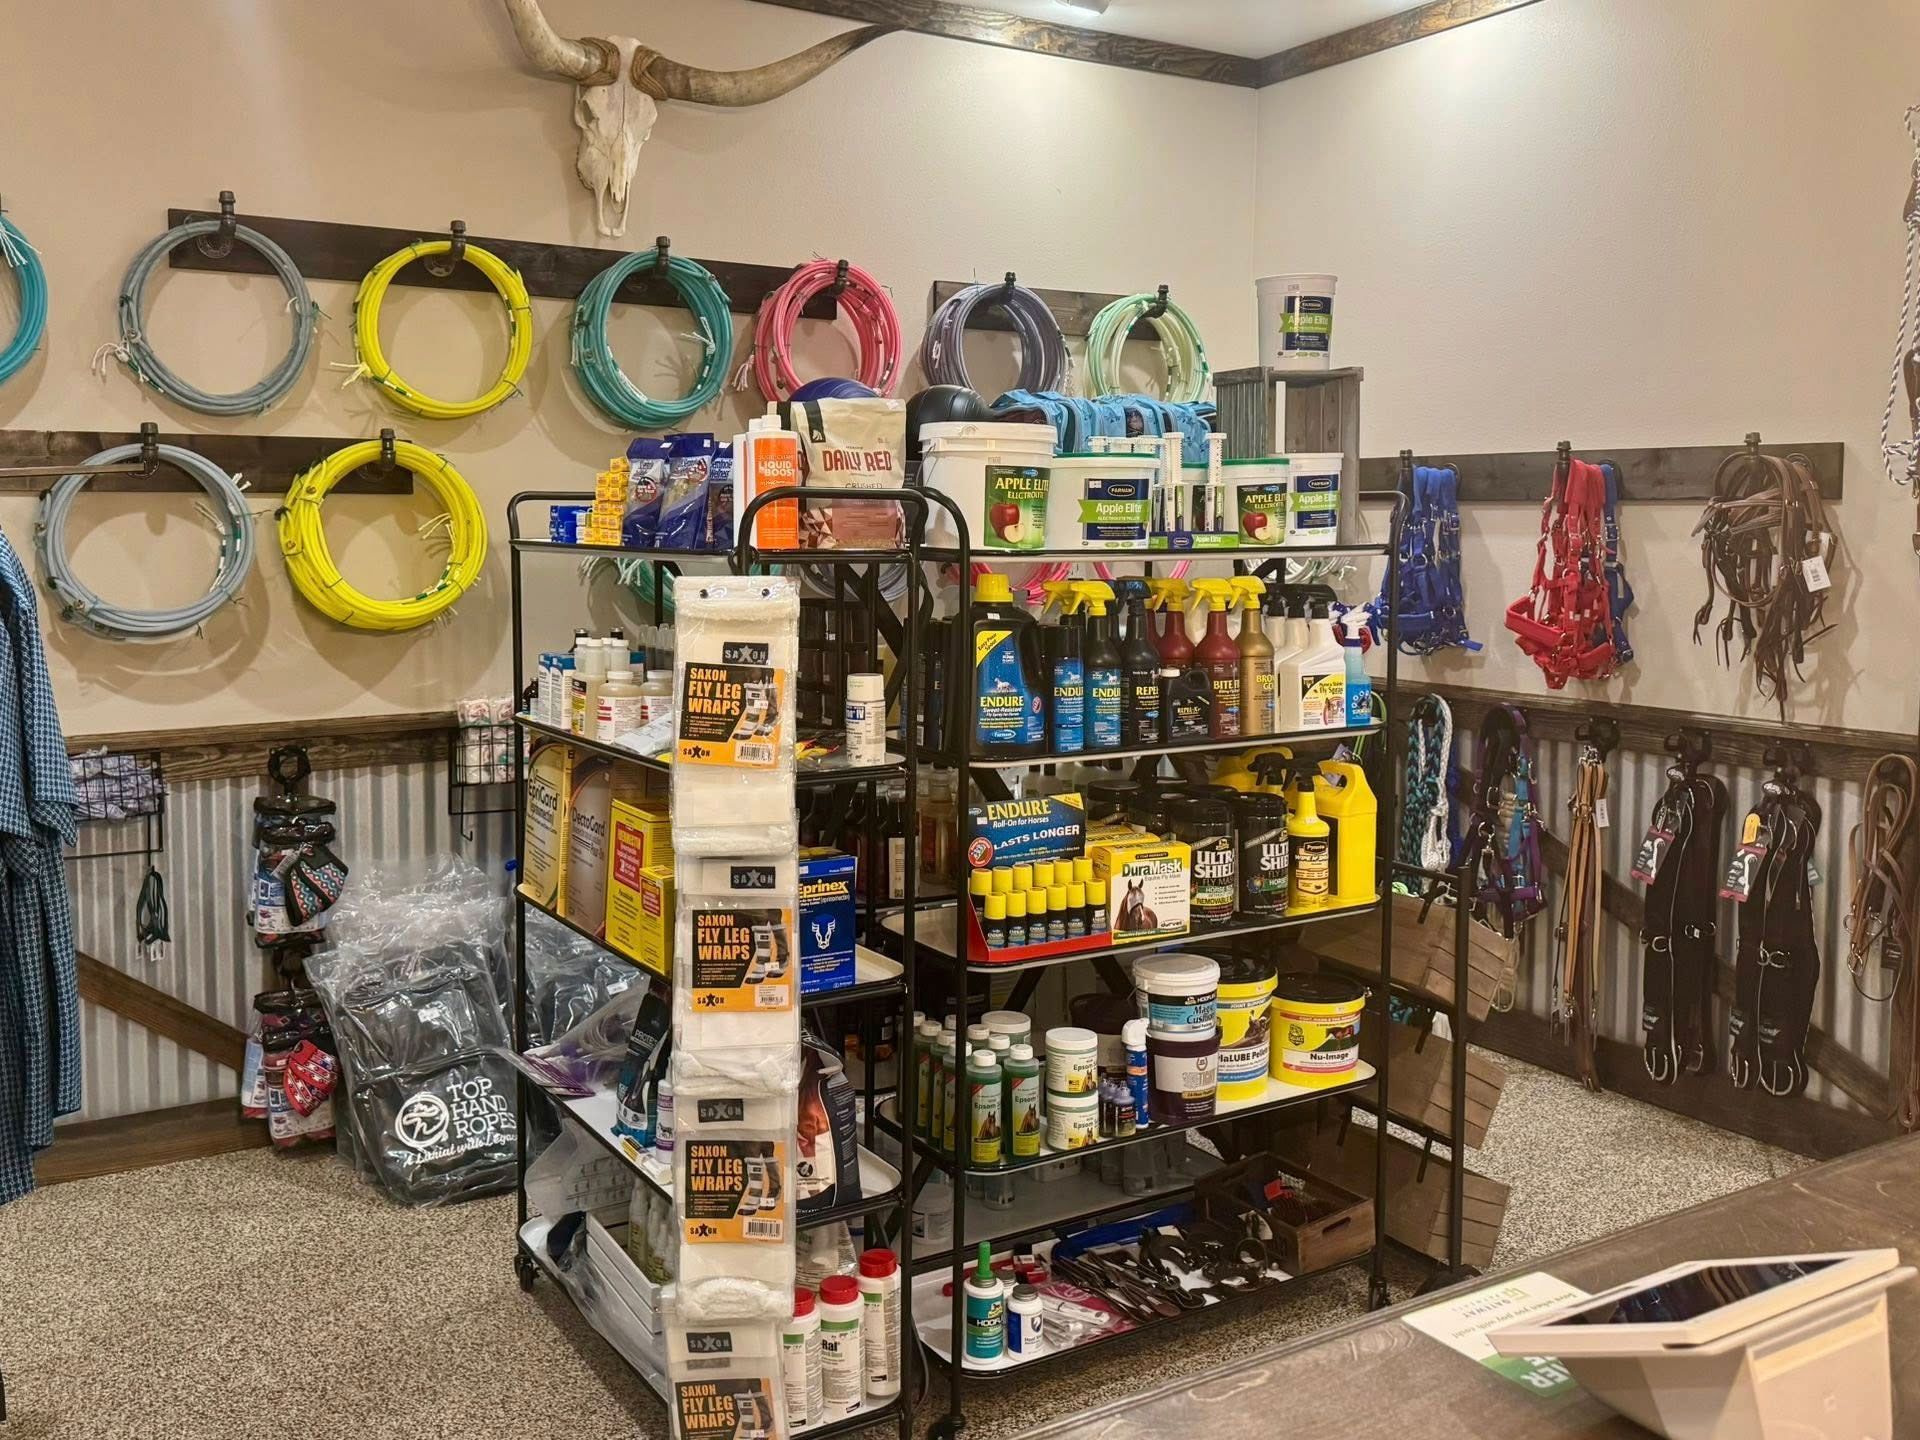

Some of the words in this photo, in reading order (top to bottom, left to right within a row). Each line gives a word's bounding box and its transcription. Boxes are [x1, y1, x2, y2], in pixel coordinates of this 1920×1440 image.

[758, 460, 792, 469] LIQUID
[822, 449, 861, 472] DAILY
[864, 450, 892, 471] RED
[995, 477, 1031, 490] APPLE
[1245, 493, 1273, 504] APPLE
[1299, 494, 1323, 505] Apple
[1096, 502, 1124, 515] Apple
[1125, 502, 1142, 513] Elite
[724, 645, 767, 663] SAXON
[690, 667, 727, 681] SAXON
[688, 680, 713, 698] FLY
[715, 683, 742, 700] LEG
[1213, 680, 1233, 690] BITE
[688, 697, 741, 716] WRAPS
[980, 696, 1025, 708] ENDURE
[682, 745, 710, 759] SAXON
[528, 778, 559, 811] EpriGard
[987, 798, 1051, 820] ENDURE
[572, 806, 605, 837] DectoGard
[993, 819, 1017, 829] Roll-On
[1028, 816, 1049, 824] Horses
[993, 833, 1030, 850] LASTS
[1033, 824, 1080, 840] LONGER
[1122, 858, 1182, 877] DuraMask
[733, 869, 773, 887] SAXON
[697, 915, 734, 927] SAXON
[697, 928, 720, 944] FLY
[724, 928, 750, 944] LEG
[698, 944, 750, 960] WRAPS
[697, 993, 724, 1007] SAXON
[1310, 1052, 1349, 1061] Nu-Image
[1073, 1063, 1093, 1071] Epsom
[446, 1077, 492, 1102] TOP
[974, 1102, 996, 1110] Epsom
[1015, 1095, 1036, 1103] Epsom
[450, 1094, 508, 1121] HAND
[453, 1111, 517, 1139] ROPES
[457, 1137, 485, 1153] with
[690, 1145, 727, 1157] SAXON
[690, 1159, 714, 1174] FLY
[717, 1159, 743, 1174] LEG
[690, 1175, 743, 1191] WRAPS
[689, 1335, 730, 1351] SAXON
[681, 1384, 717, 1398] SAXON
[682, 1398, 704, 1413] FLY
[708, 1395, 734, 1412] LEG
[684, 1412, 735, 1430] WRAPS
